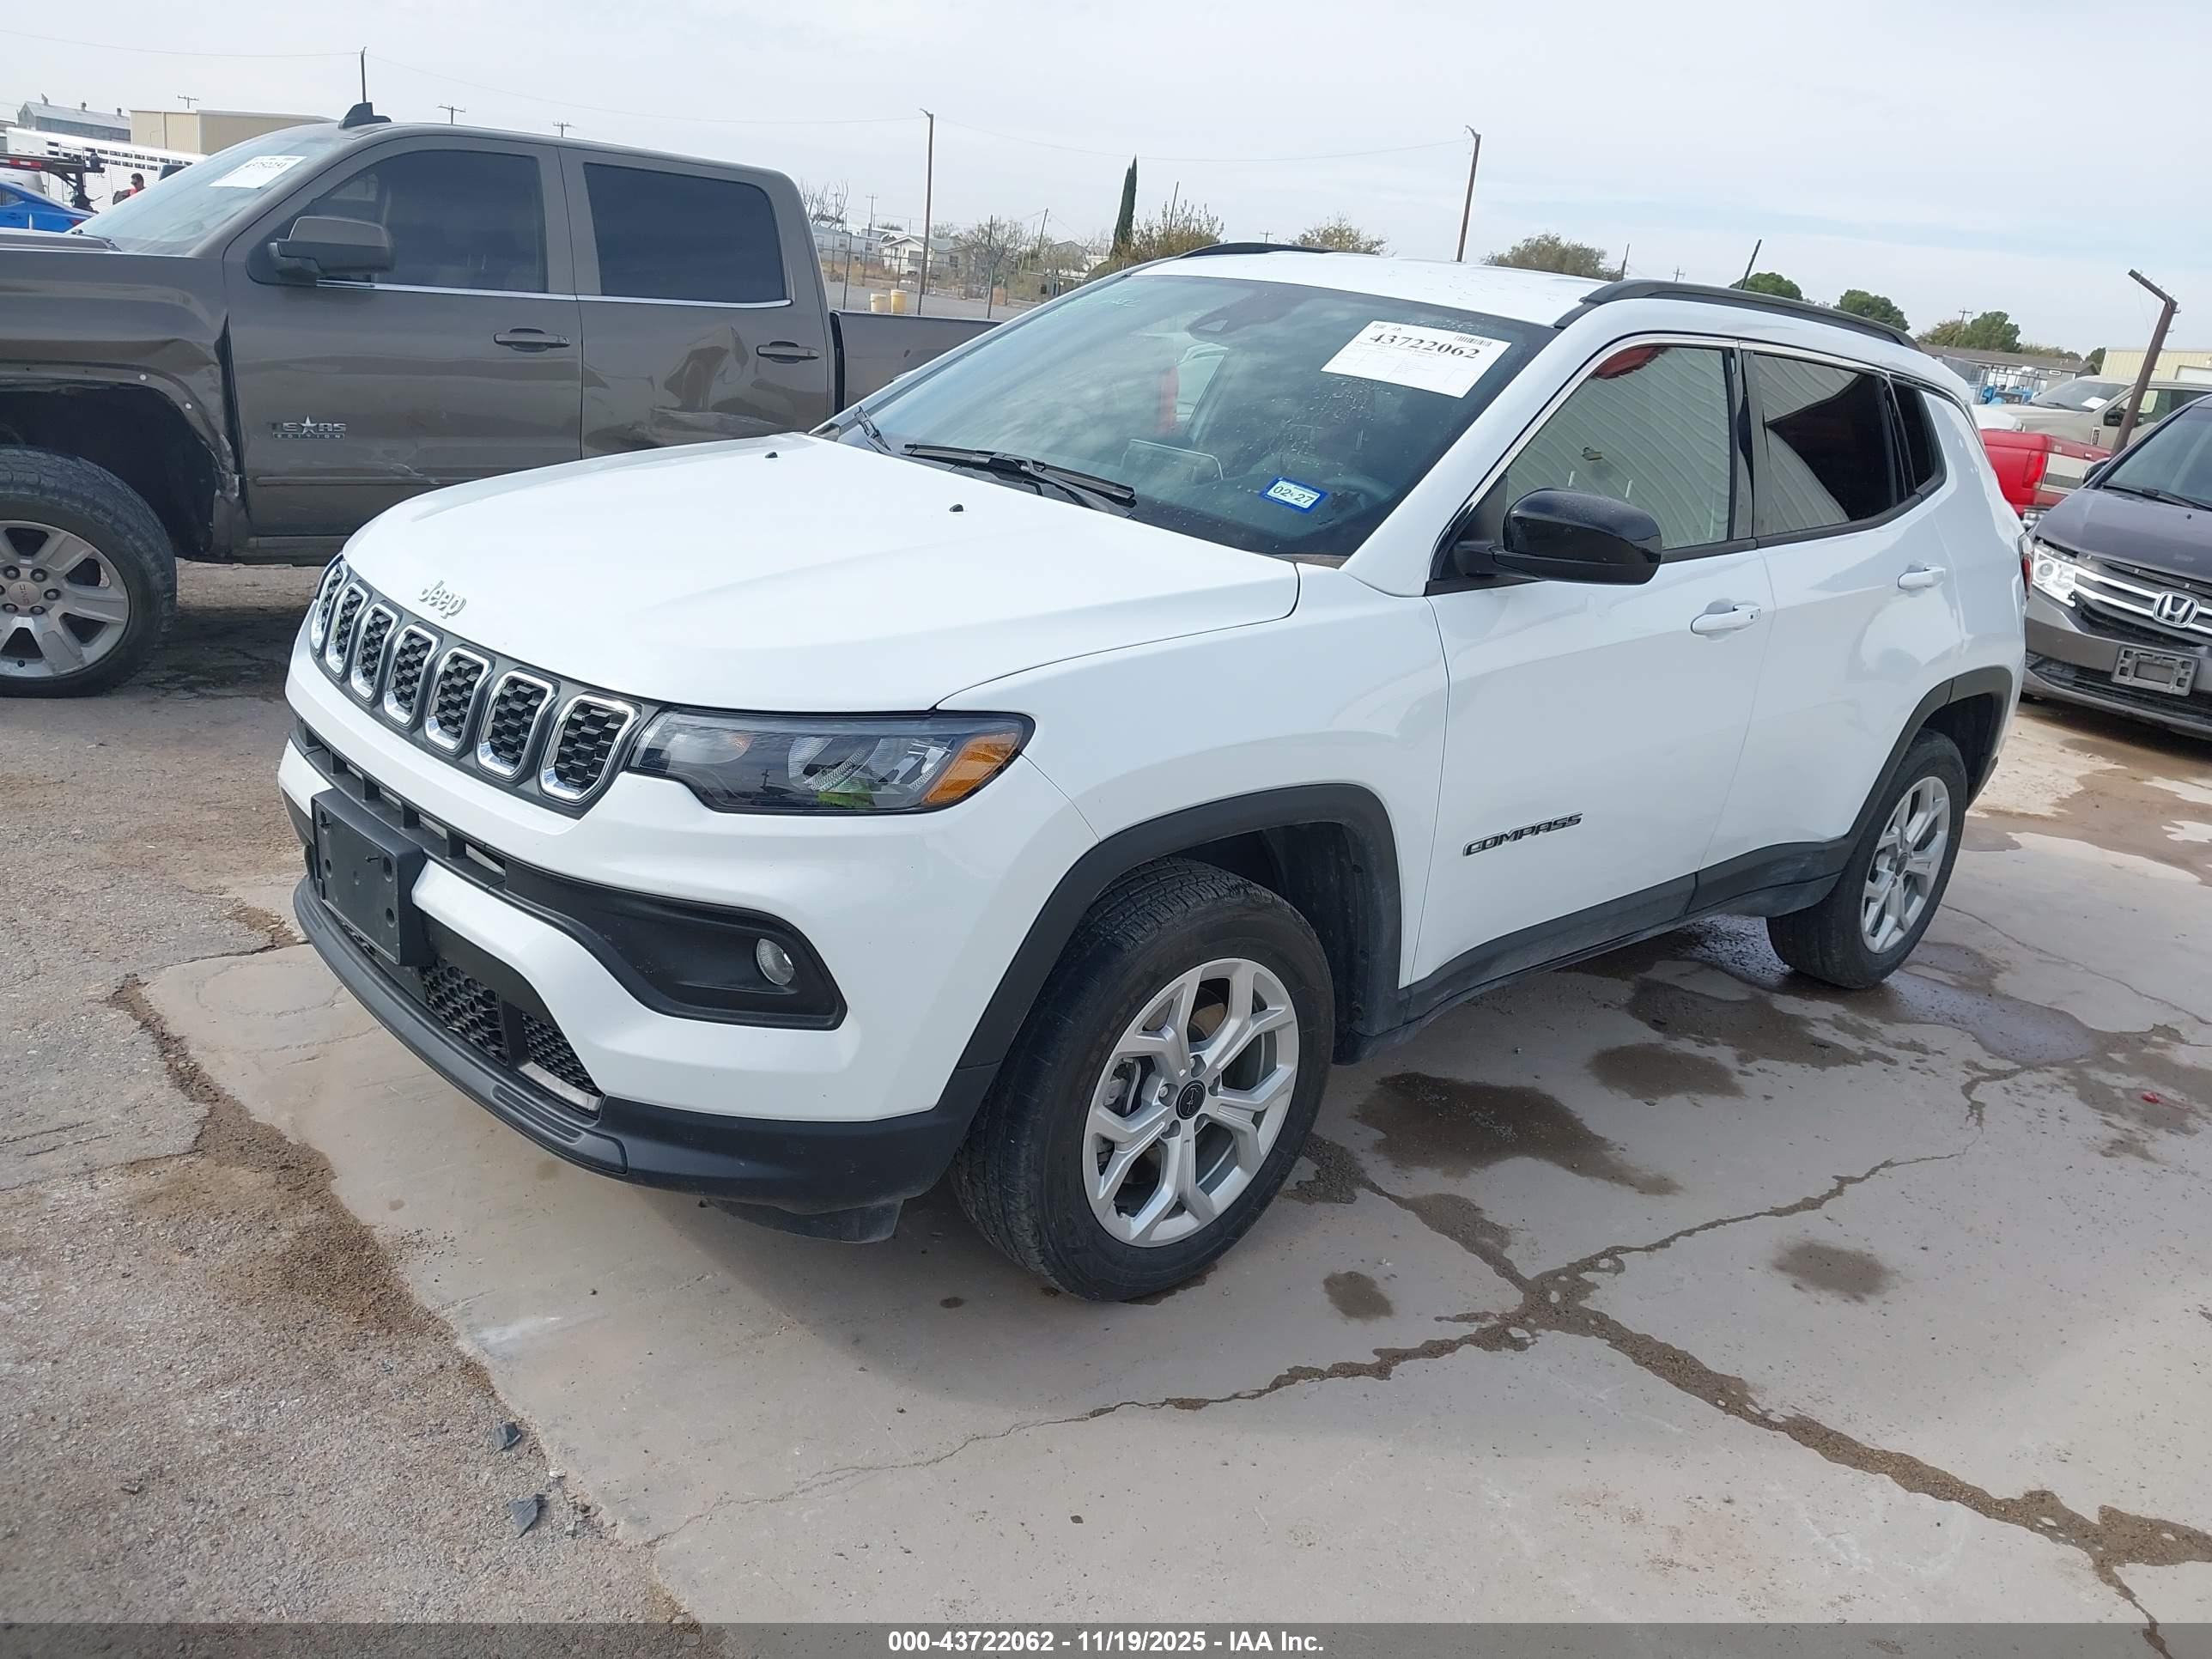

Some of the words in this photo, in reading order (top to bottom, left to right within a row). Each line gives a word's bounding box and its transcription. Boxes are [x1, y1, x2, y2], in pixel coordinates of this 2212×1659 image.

[1369, 333, 1480, 359] 43722062
[418, 580, 467, 620] Jeep
[1462, 811, 1584, 857] COMPASS
